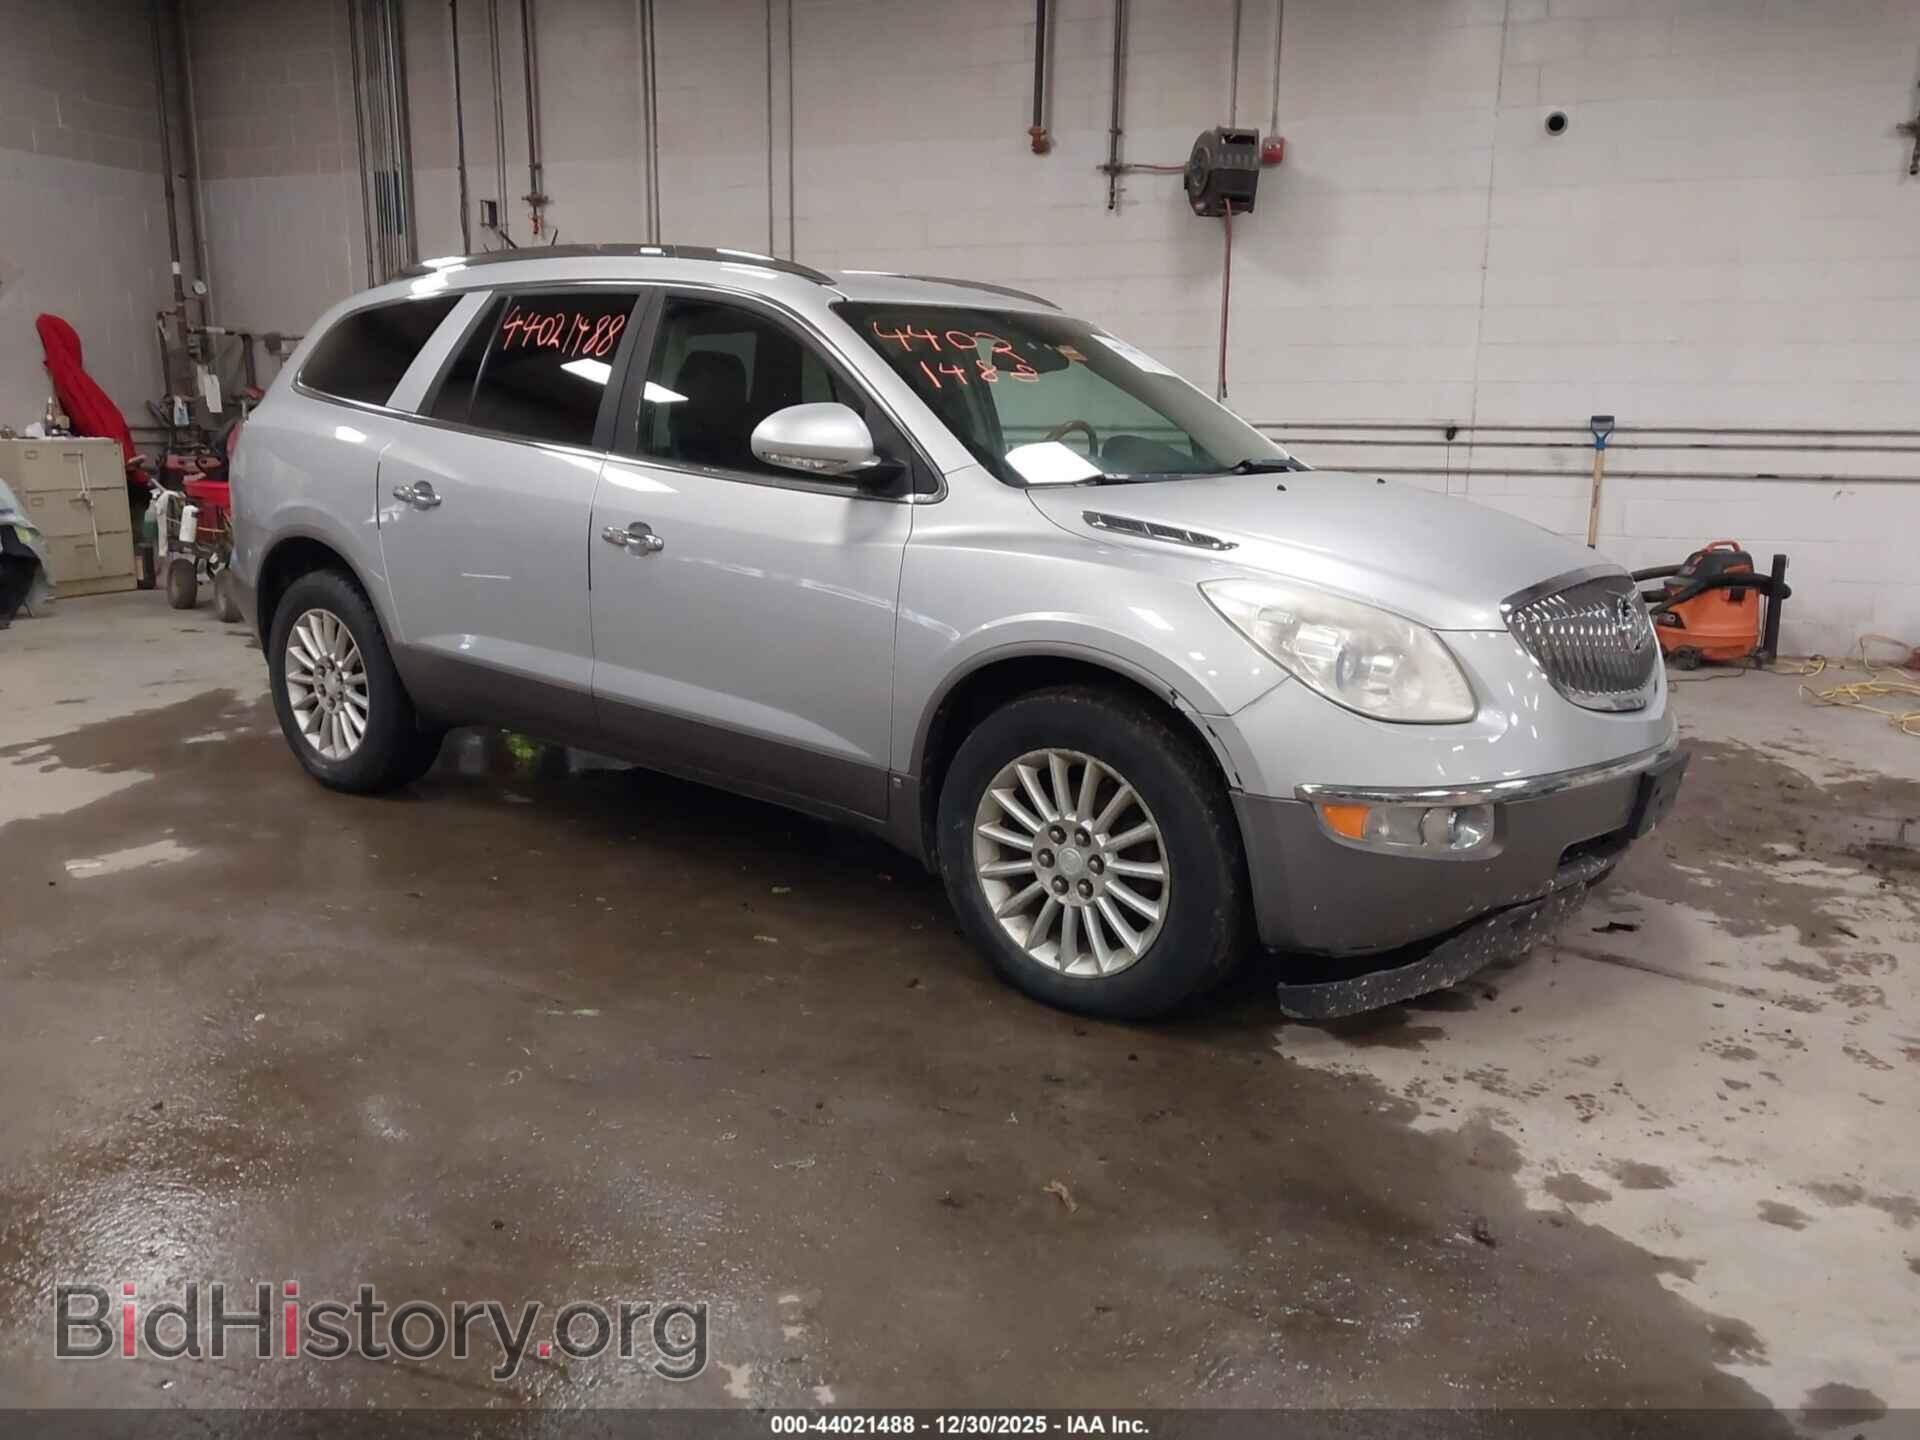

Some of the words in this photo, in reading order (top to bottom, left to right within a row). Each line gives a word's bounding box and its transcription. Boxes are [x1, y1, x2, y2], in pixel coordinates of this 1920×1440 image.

[504, 306, 625, 357] 44021488
[873, 321, 1027, 363] 4402
[920, 360, 1039, 388] 1488
